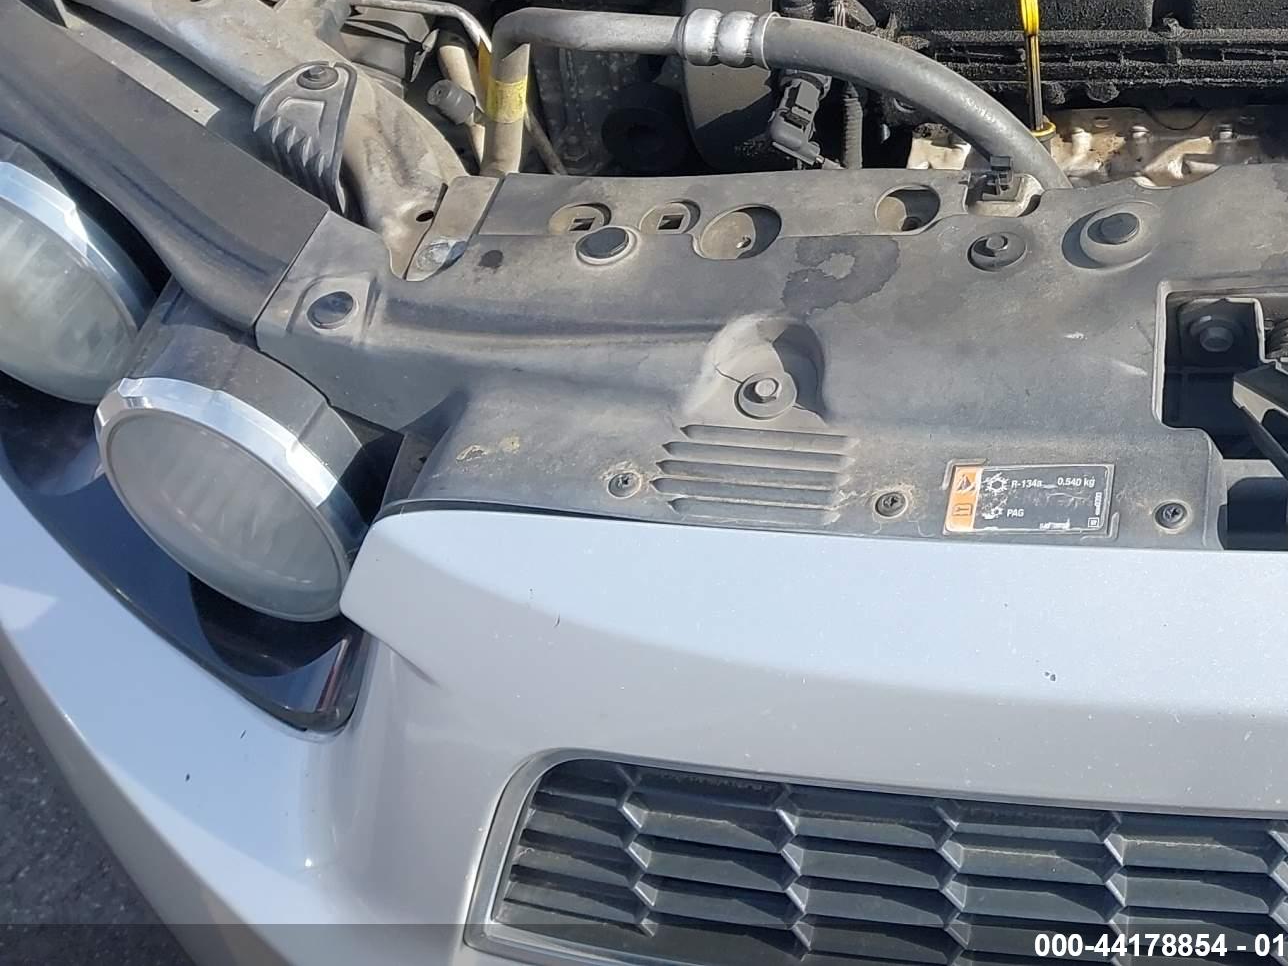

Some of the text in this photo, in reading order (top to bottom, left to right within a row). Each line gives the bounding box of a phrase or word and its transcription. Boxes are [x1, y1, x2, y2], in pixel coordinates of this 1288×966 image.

[1010, 476, 1096, 489] R-134a 0.540 kg
[1006, 508, 1025, 518] PAG
